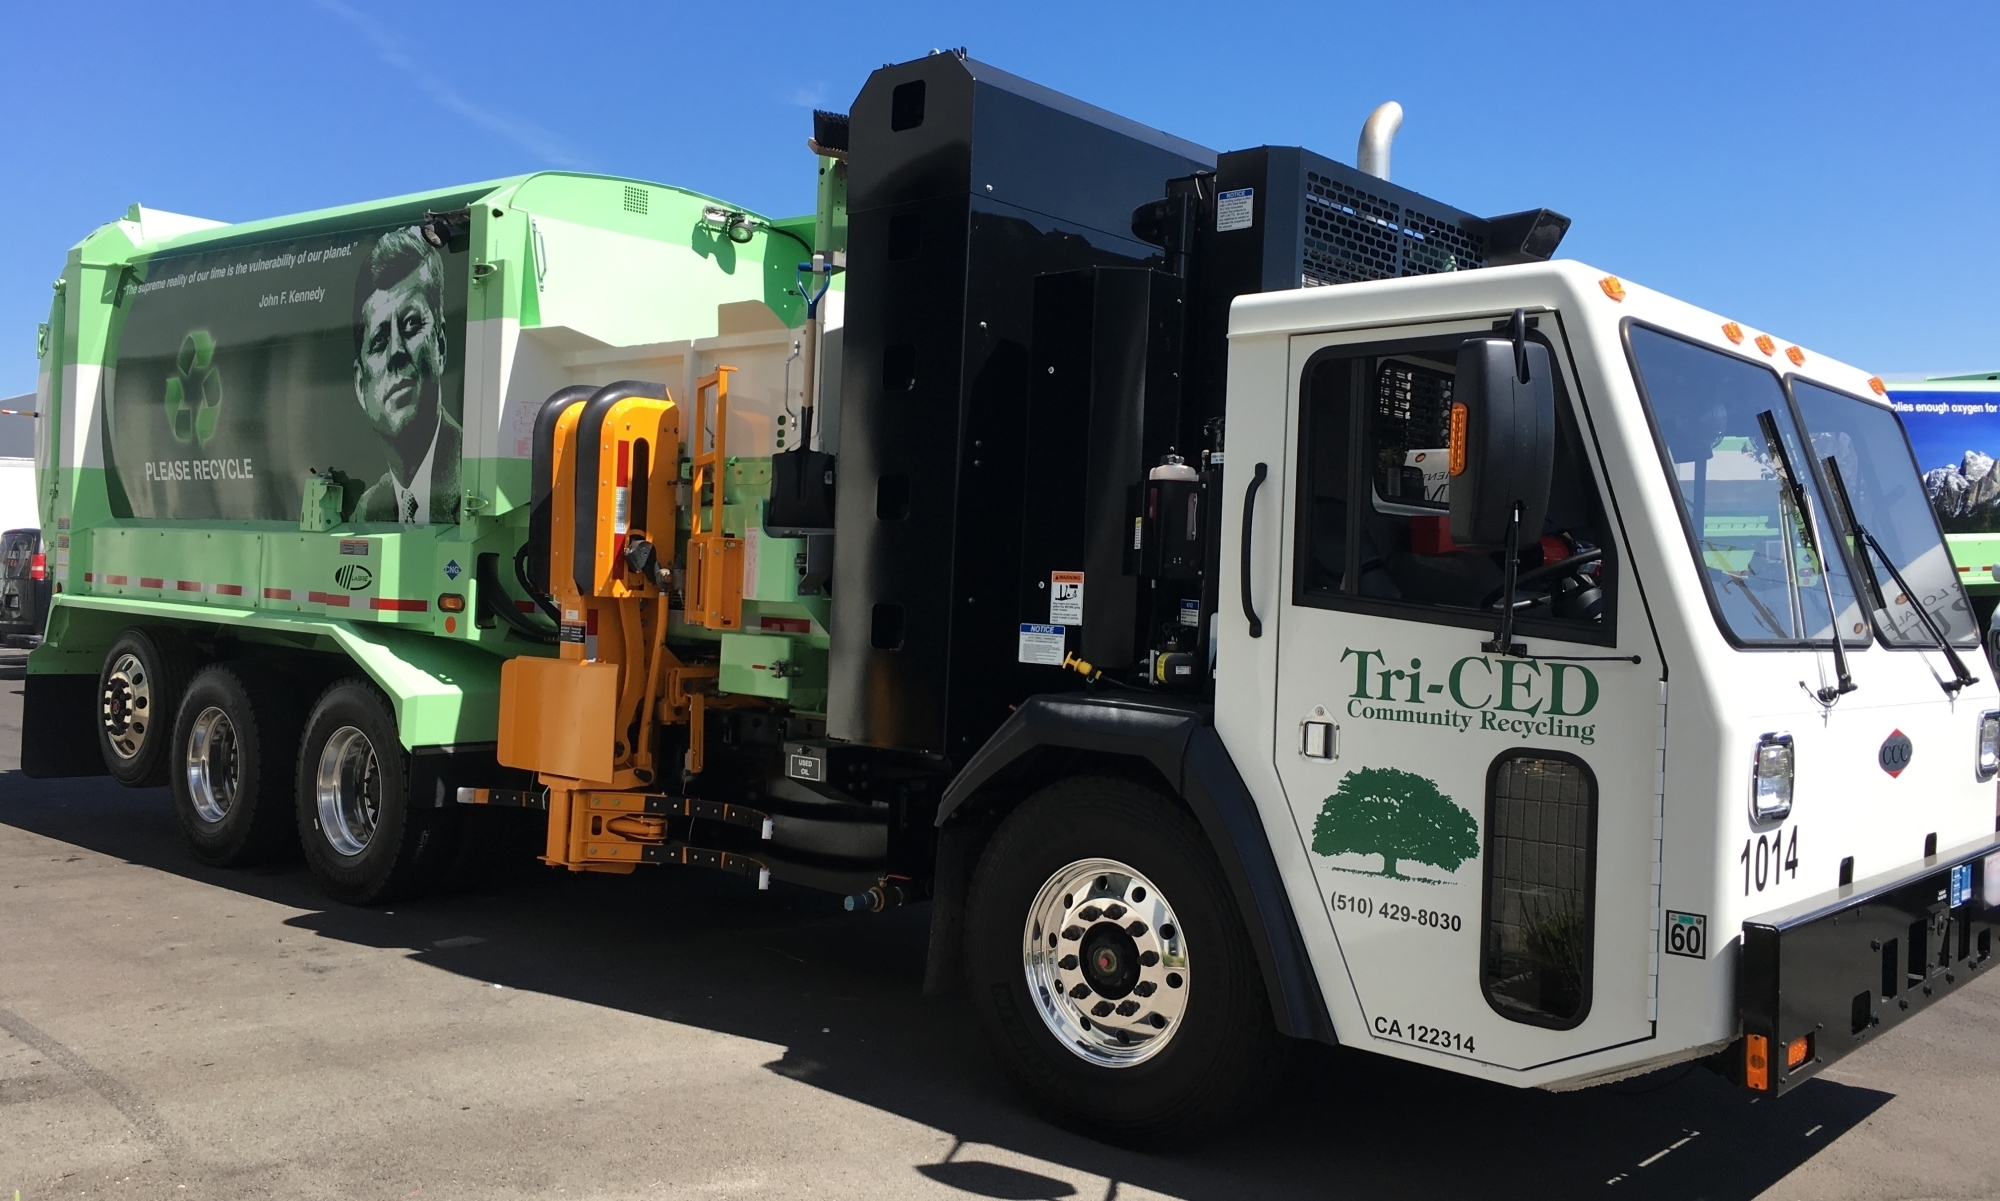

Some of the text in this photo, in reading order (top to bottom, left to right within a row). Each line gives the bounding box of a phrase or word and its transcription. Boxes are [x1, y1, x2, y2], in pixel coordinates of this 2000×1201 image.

[138, 280, 166, 294] supreme
[166, 274, 188, 288] reality
[188, 270, 197, 284] of
[197, 271, 209, 281] our
[210, 267, 226, 280] time
[226, 264, 234, 276] is
[235, 262, 248, 275] the
[249, 253, 297, 269] vulnerability
[297, 250, 307, 264] of
[307, 250, 323, 263] our
[259, 286, 326, 307] John F. Kennedy
[1915, 402, 1950, 415] enough
[1951, 403, 1984, 415] oxygen
[1985, 402, 1998, 413] for
[145, 458, 254, 481] PLEASE RECYCLE
[445, 565, 460, 574] CNG
[1030, 625, 1055, 634] NOTICE
[1339, 646, 1600, 719] Tri-CED
[1346, 699, 1596, 746] Community Recycling
[798, 759, 812, 767] USED
[1882, 743, 1909, 766] CCC
[1740, 825, 1799, 897] 1014
[1331, 891, 1462, 932] (510) 429-8030
[1670, 923, 1701, 954] 60
[1374, 1016, 1476, 1054] CA 122314
